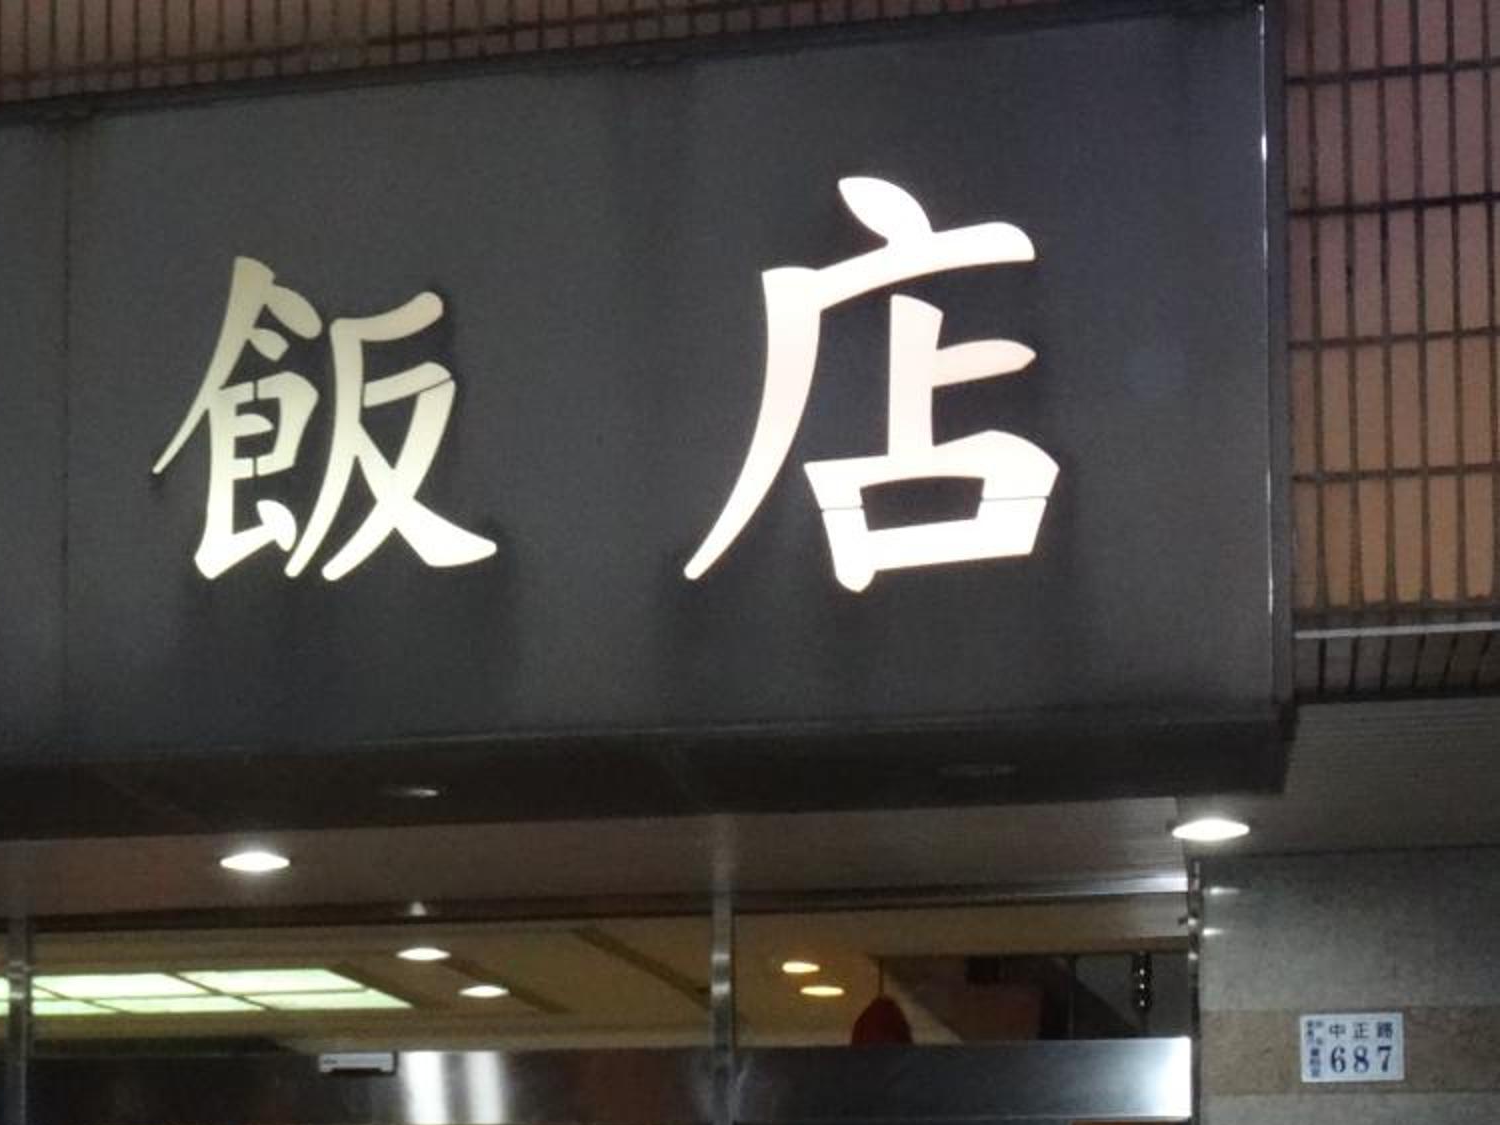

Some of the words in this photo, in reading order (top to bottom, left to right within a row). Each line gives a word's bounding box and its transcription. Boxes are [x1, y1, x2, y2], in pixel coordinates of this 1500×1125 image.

[1329, 1021, 1393, 1039] 中正路
[1330, 1045, 1392, 1073] 687
